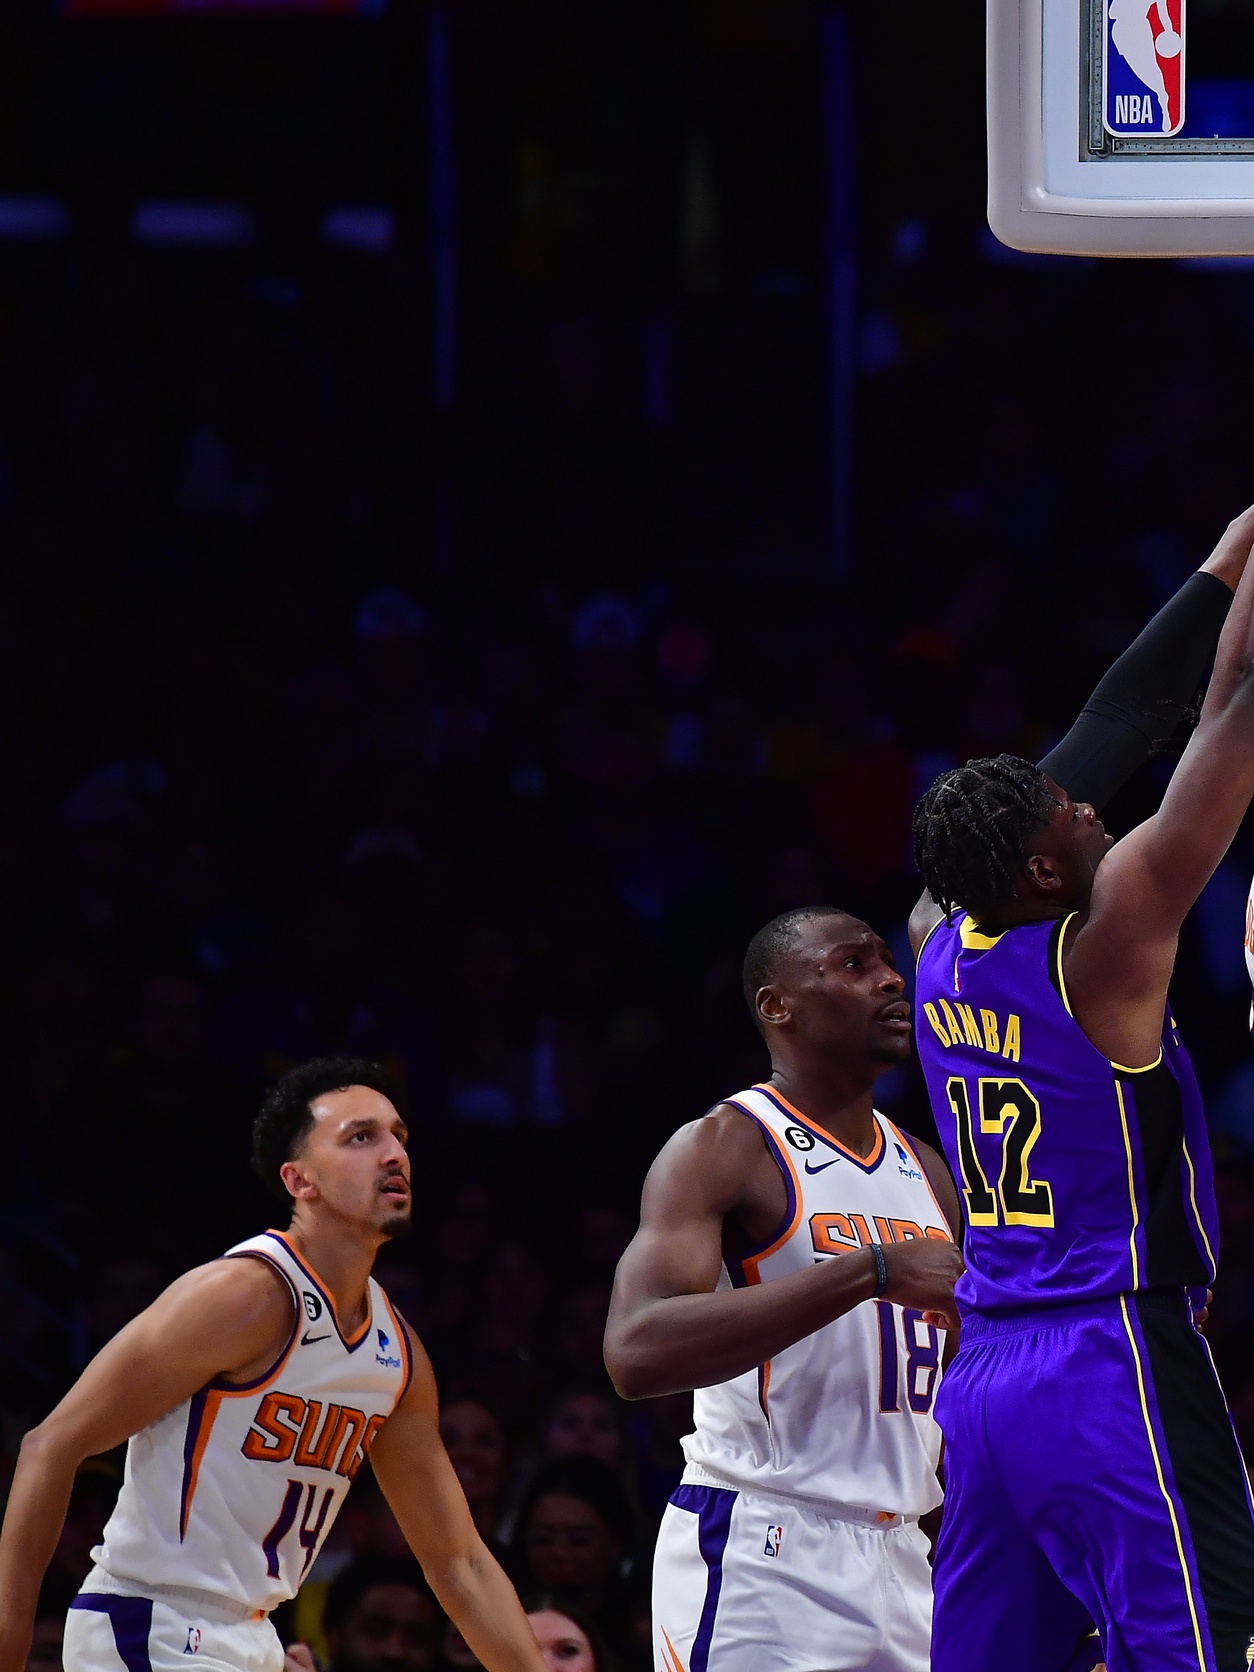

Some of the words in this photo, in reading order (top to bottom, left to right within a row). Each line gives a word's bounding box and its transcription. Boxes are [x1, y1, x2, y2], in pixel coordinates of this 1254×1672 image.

[1115, 95, 1153, 124] NBA
[923, 999, 1020, 1063] BAMBA
[898, 1166, 923, 1180] PayPal
[946, 1077, 1054, 1228] 12
[376, 1353, 400, 1368] PayPal
[873, 1301, 939, 1415] 18
[262, 1479, 335, 1580] 14
